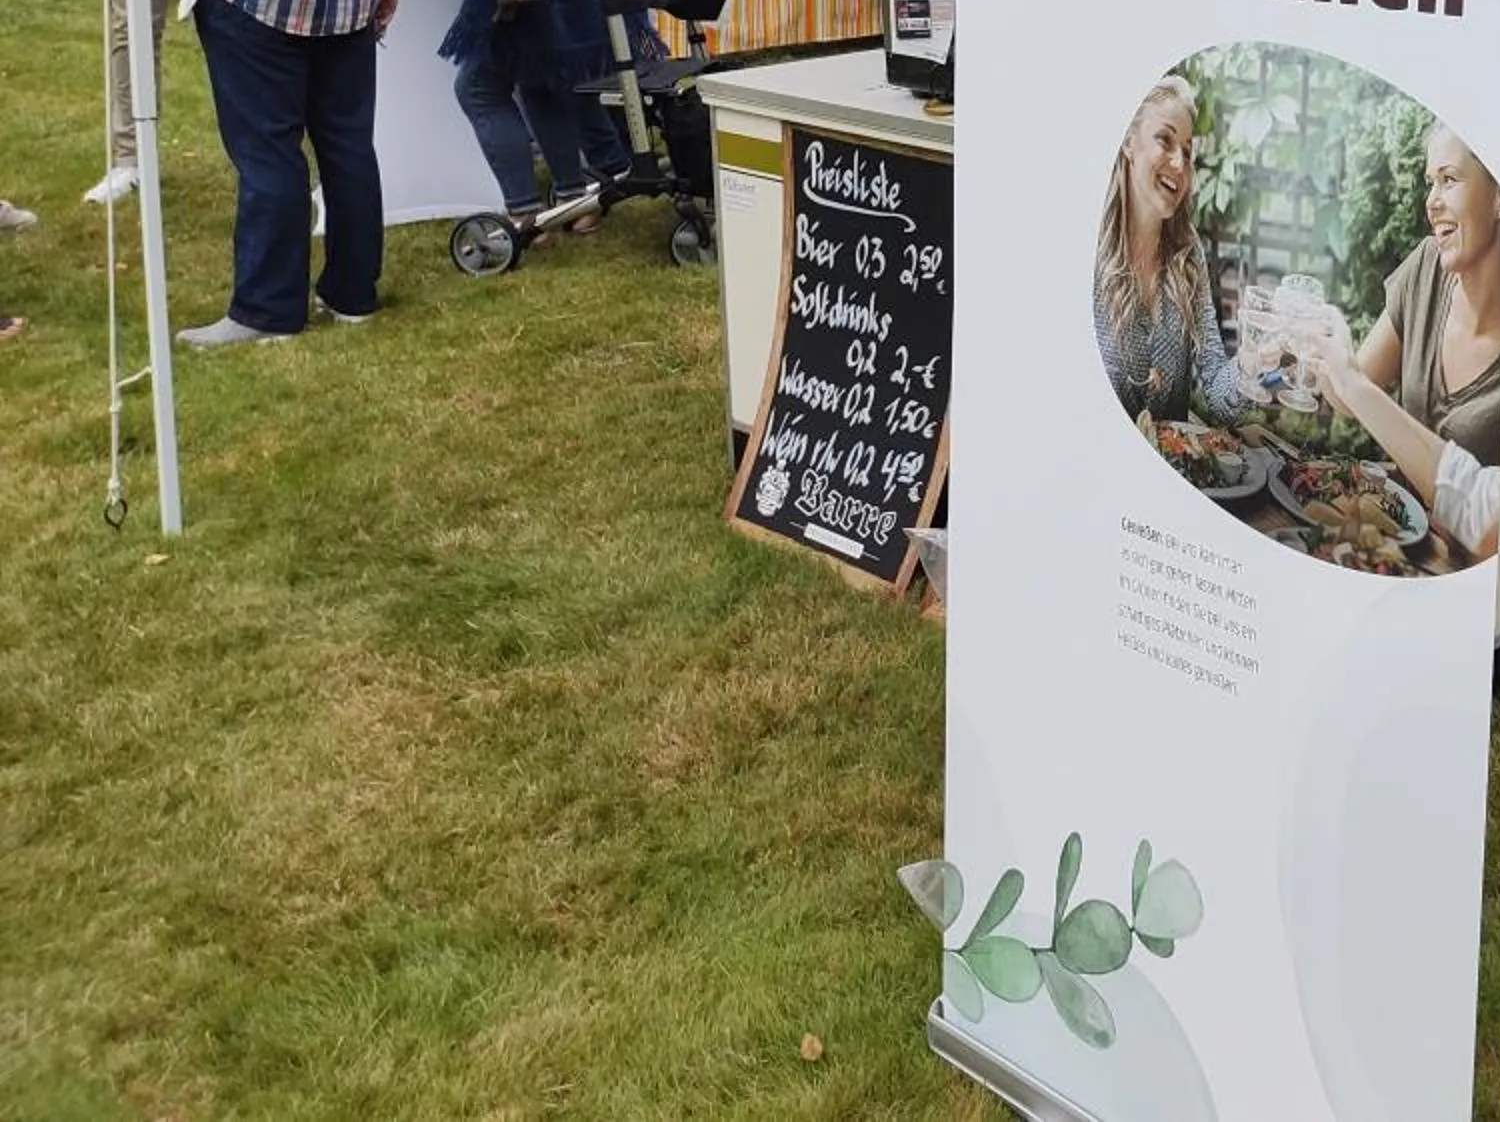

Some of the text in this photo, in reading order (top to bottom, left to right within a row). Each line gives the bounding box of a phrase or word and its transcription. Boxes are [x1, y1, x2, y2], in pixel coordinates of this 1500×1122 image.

[804, 140, 902, 210] Preisliste
[796, 213, 844, 269] Bier
[855, 233, 886, 278] 0,3
[790, 273, 893, 342] Softdrinks
[777, 354, 847, 413] Wasser
[844, 382, 875, 427] 0,2
[846, 339, 876, 377] 0,2
[760, 408, 809, 464] Wein
[843, 439, 876, 487] 0,2
[794, 468, 897, 546] Barre
